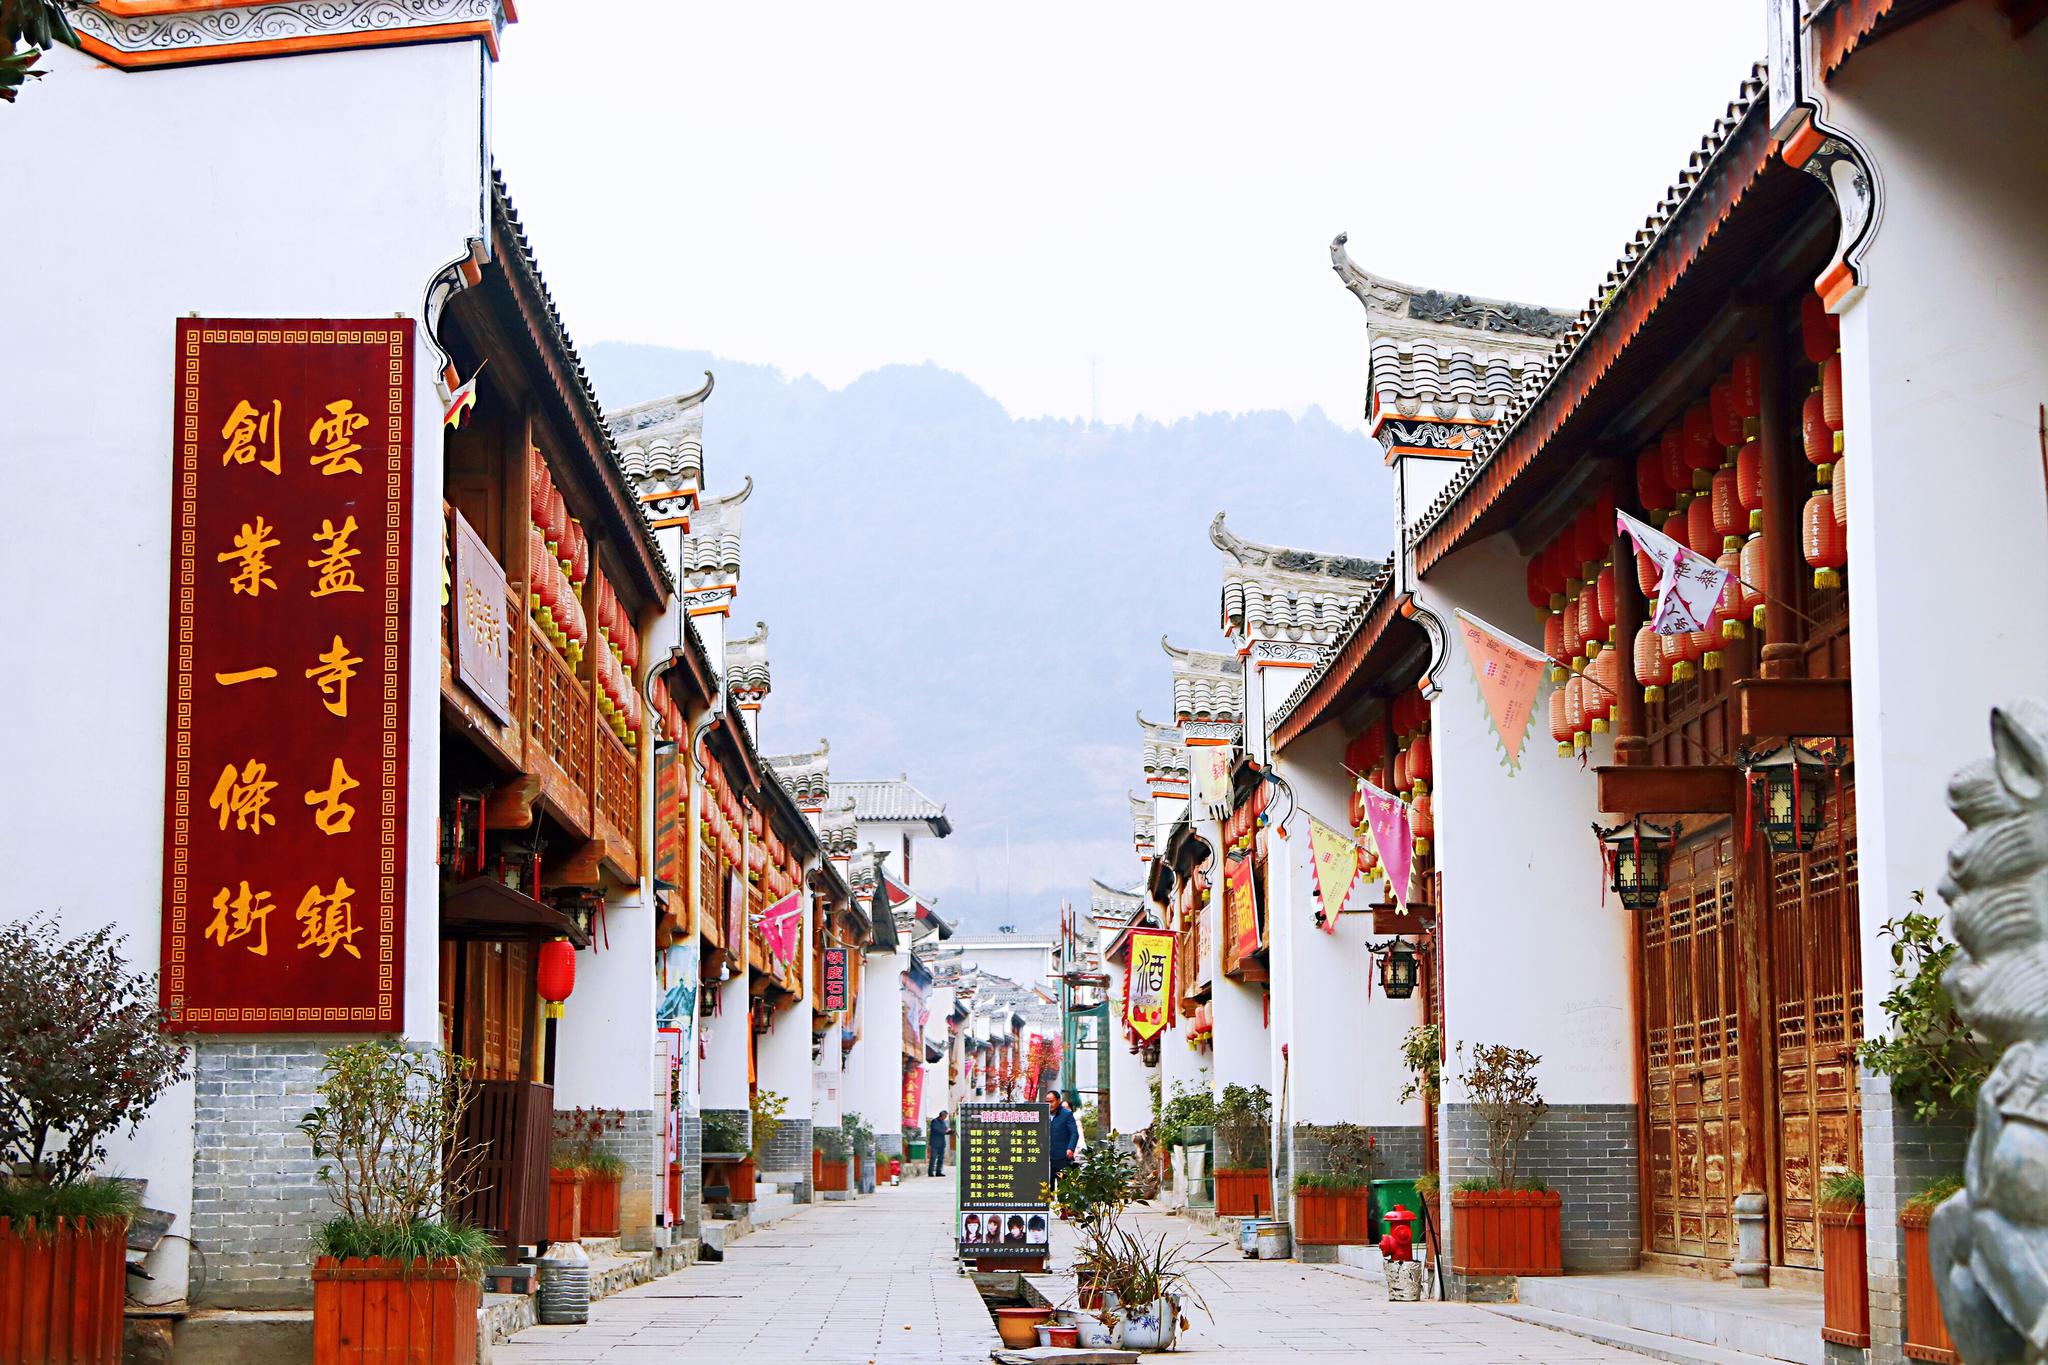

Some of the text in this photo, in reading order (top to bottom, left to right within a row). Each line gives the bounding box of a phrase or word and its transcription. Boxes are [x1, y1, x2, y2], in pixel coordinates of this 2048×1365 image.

[205, 399, 281, 957] 創業一條街
[826, 950, 845, 1009] 铁皮石斛
[1137, 948, 1166, 996] 酒
